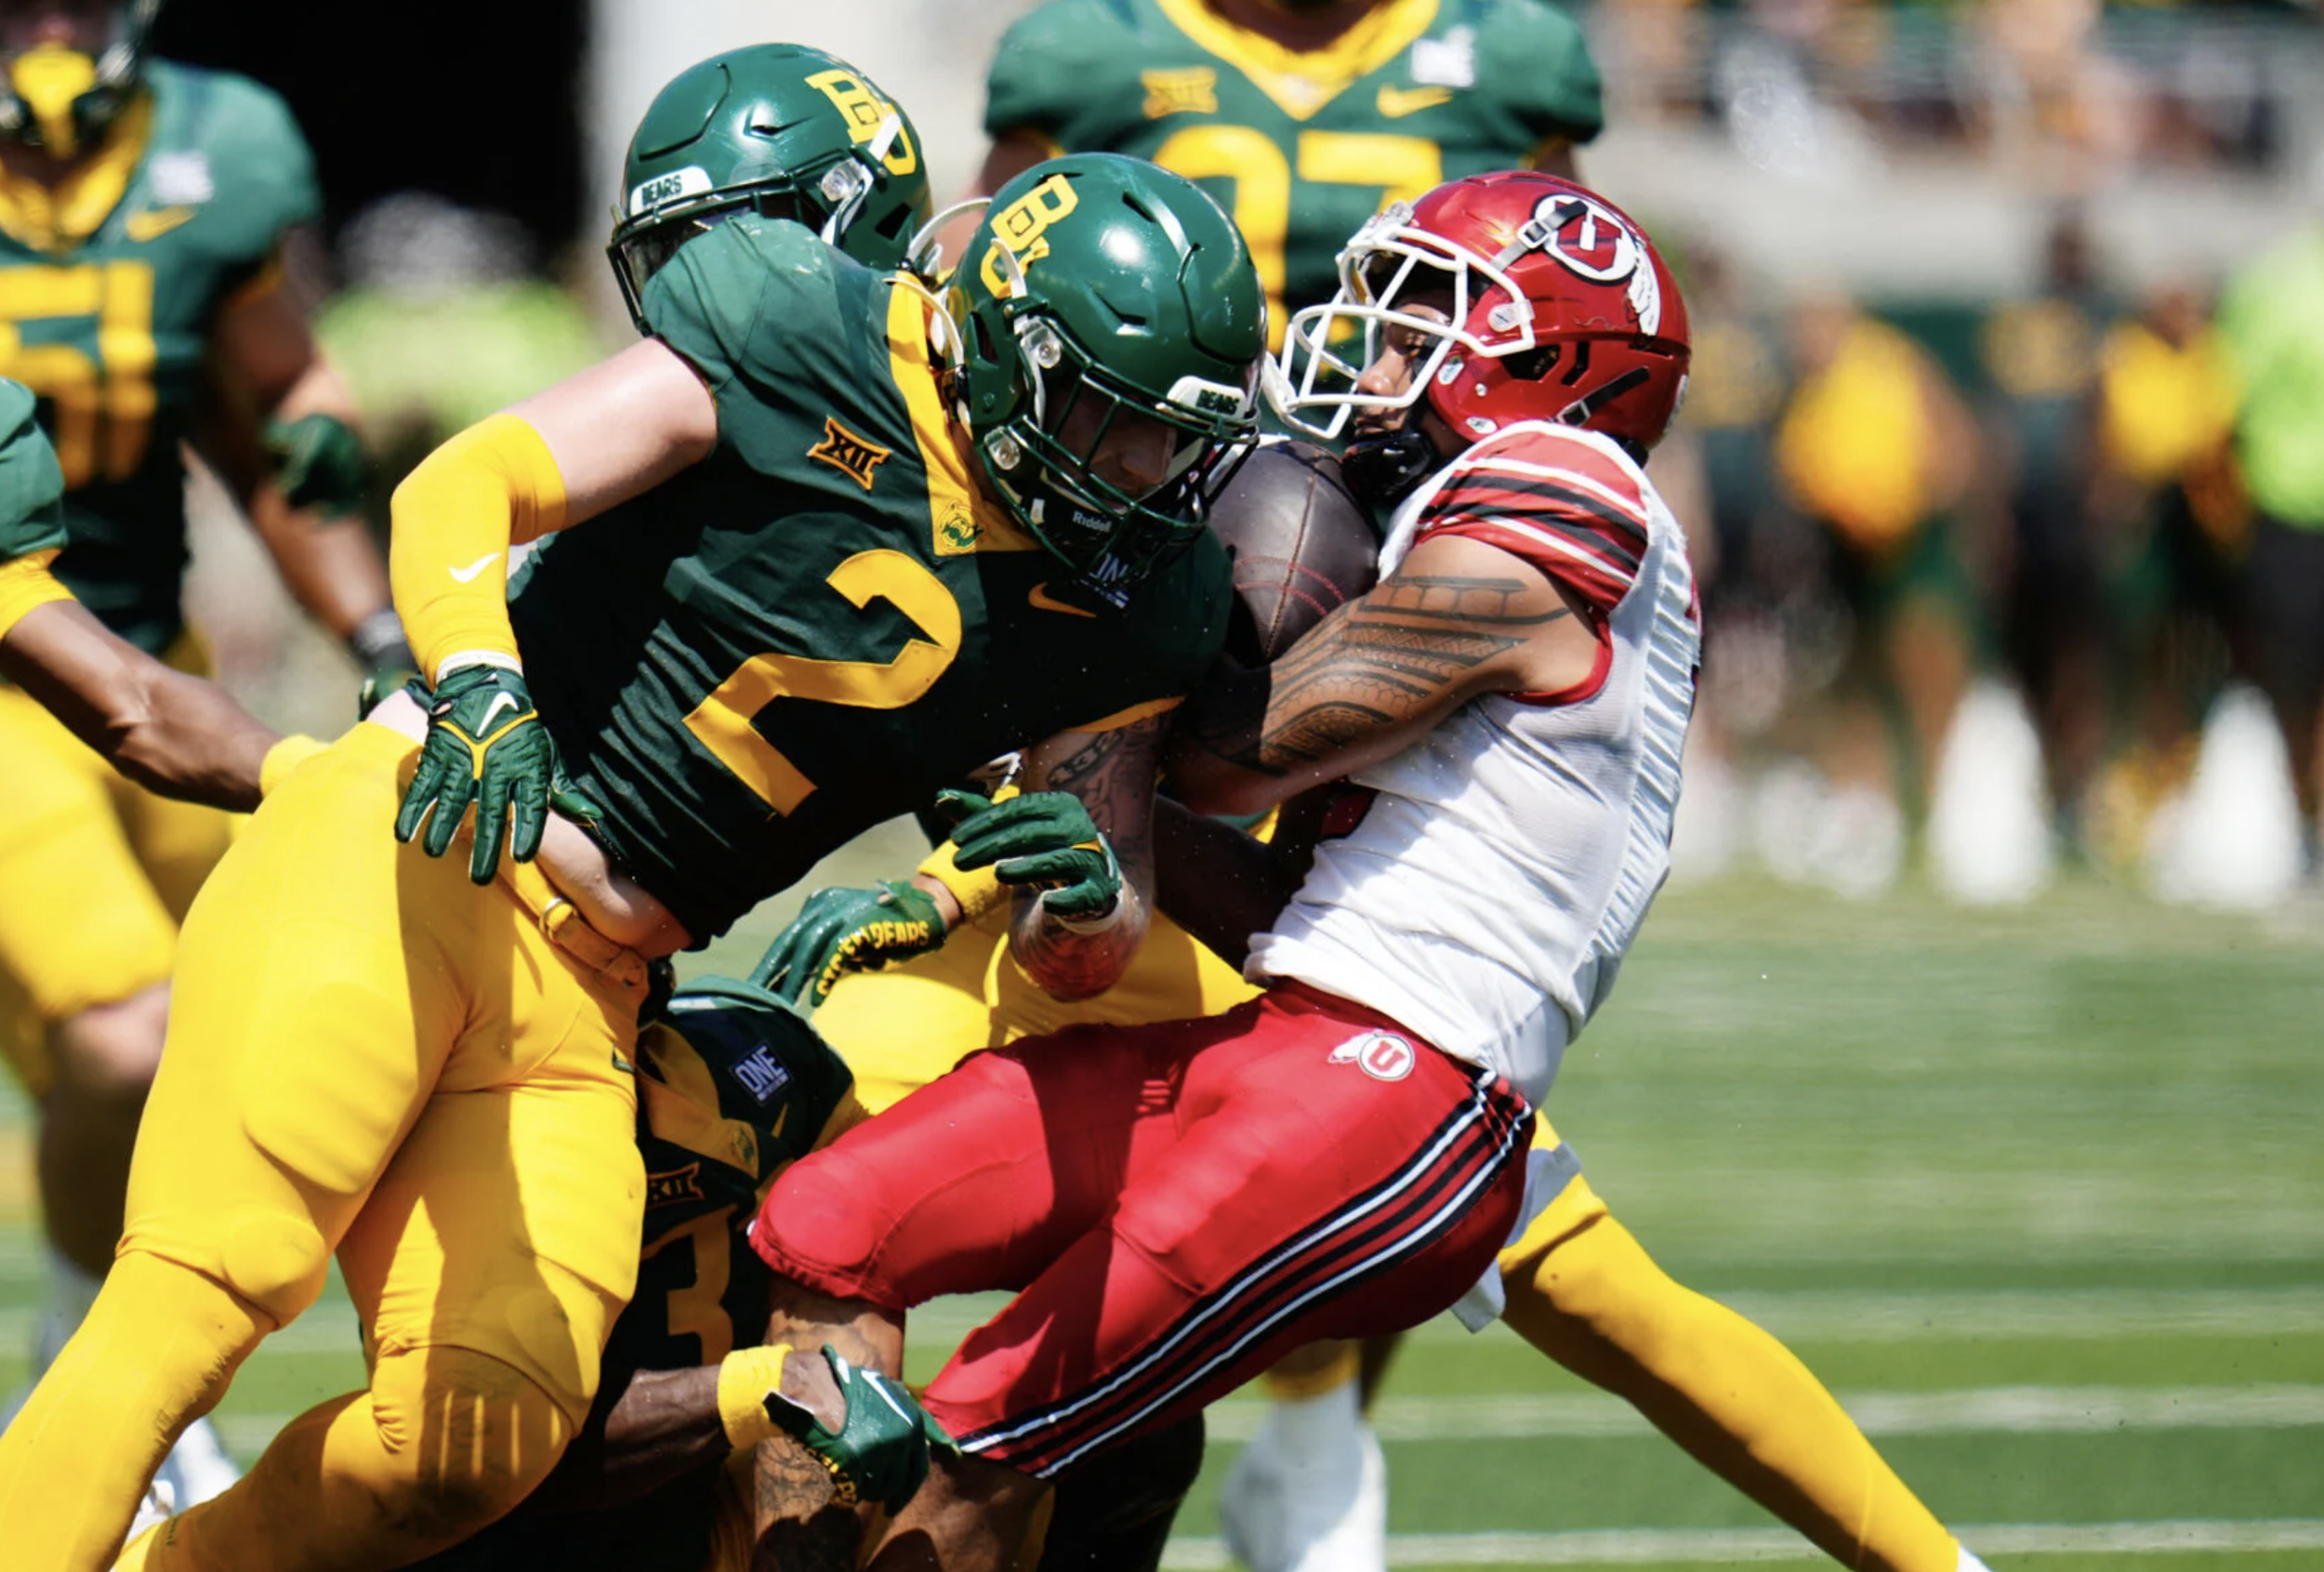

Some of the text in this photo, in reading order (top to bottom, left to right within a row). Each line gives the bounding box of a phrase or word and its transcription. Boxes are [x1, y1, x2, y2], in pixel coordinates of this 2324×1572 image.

[641, 174, 682, 207] BEARS
[1195, 389, 1240, 416] BEARS
[812, 421, 889, 484] XII
[1072, 510, 1113, 533] Riddell
[681, 548, 963, 818] 2
[734, 1045, 785, 1094] ONE
[1367, 1039, 1407, 1073] U
[641, 1203, 737, 1368] 3
